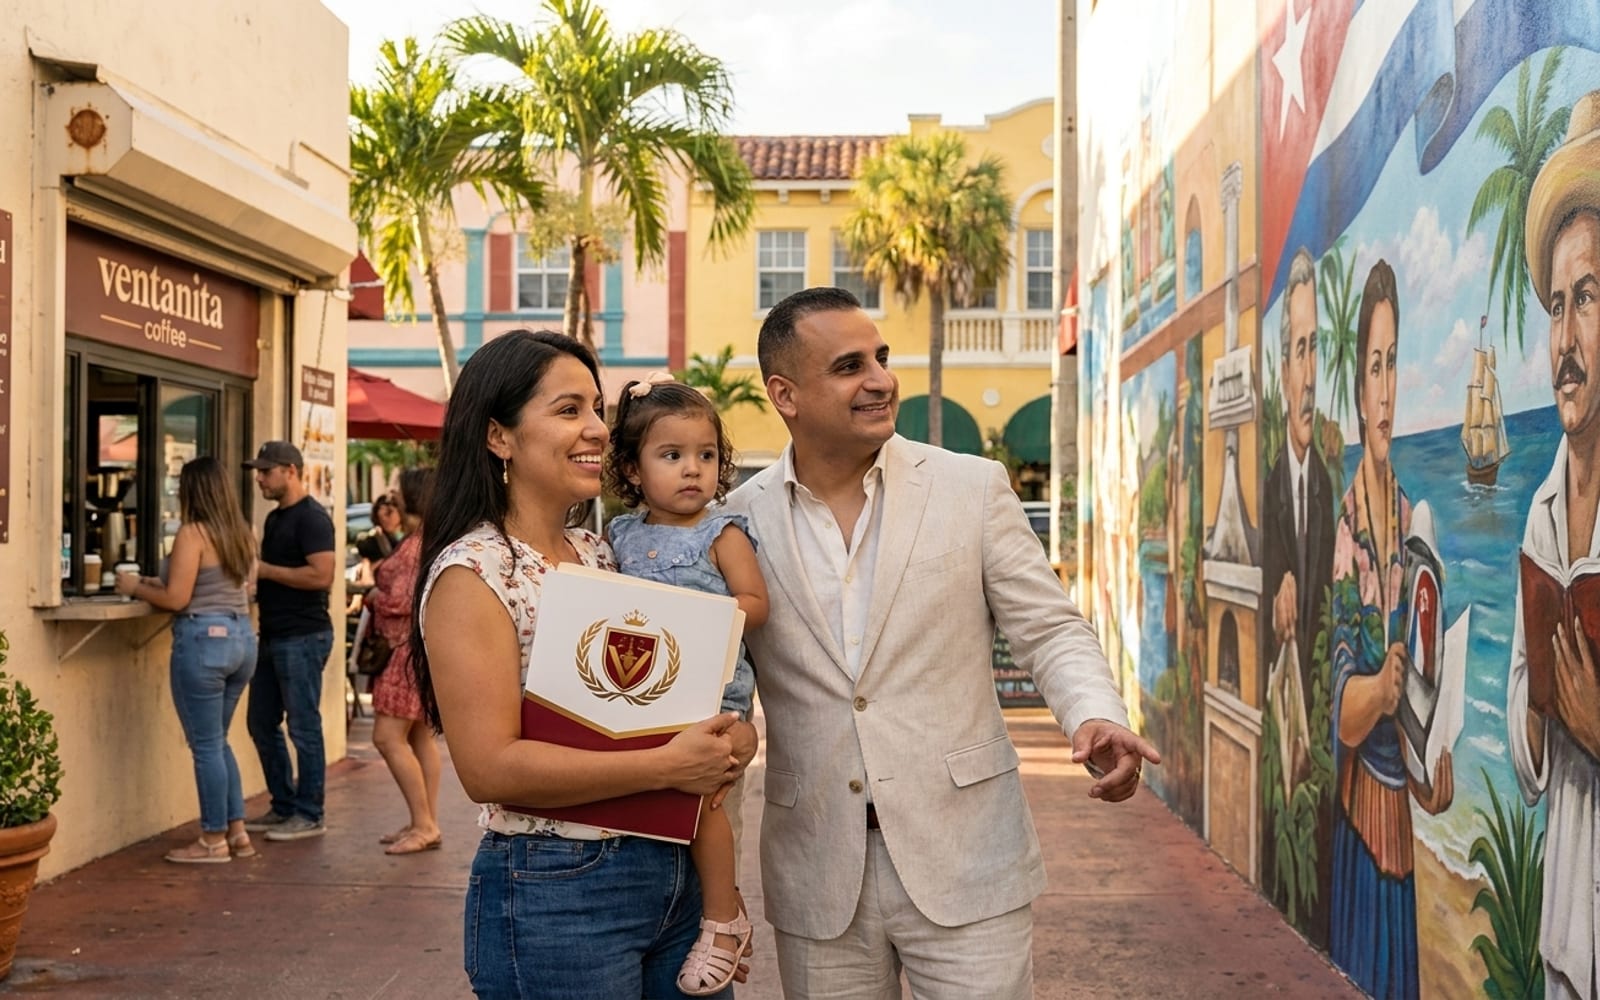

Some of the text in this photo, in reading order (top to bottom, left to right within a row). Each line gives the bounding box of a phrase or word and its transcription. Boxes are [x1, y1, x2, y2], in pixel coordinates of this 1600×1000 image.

[98, 256, 224, 330] ventanita
[144, 318, 187, 348] coffee
[608, 644, 652, 687] V
